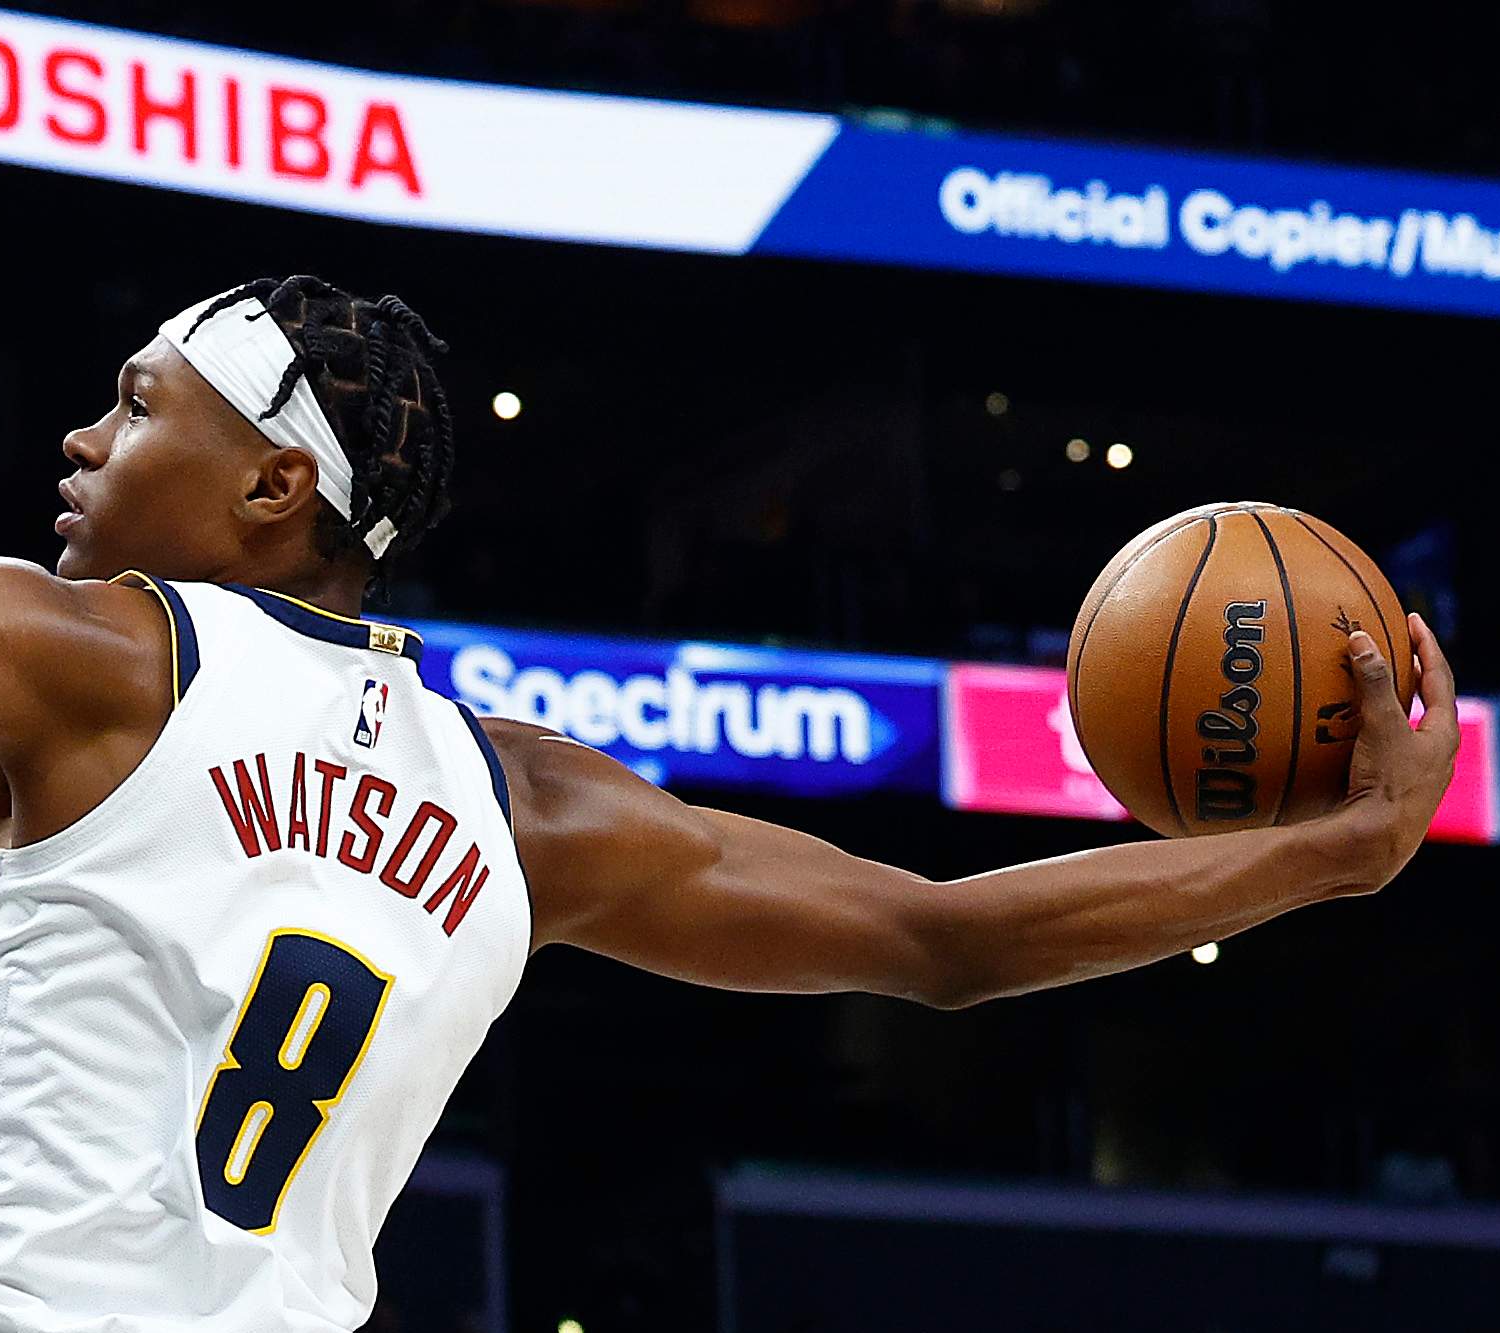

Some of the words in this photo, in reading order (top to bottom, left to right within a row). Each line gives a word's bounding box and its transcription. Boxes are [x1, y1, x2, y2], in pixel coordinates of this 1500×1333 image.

[939, 166, 1169, 249] Official
[451, 642, 873, 767] Spectrum
[1196, 598, 1268, 823] Wilson
[208, 752, 490, 937] WATSON
[195, 927, 396, 1236] 8
